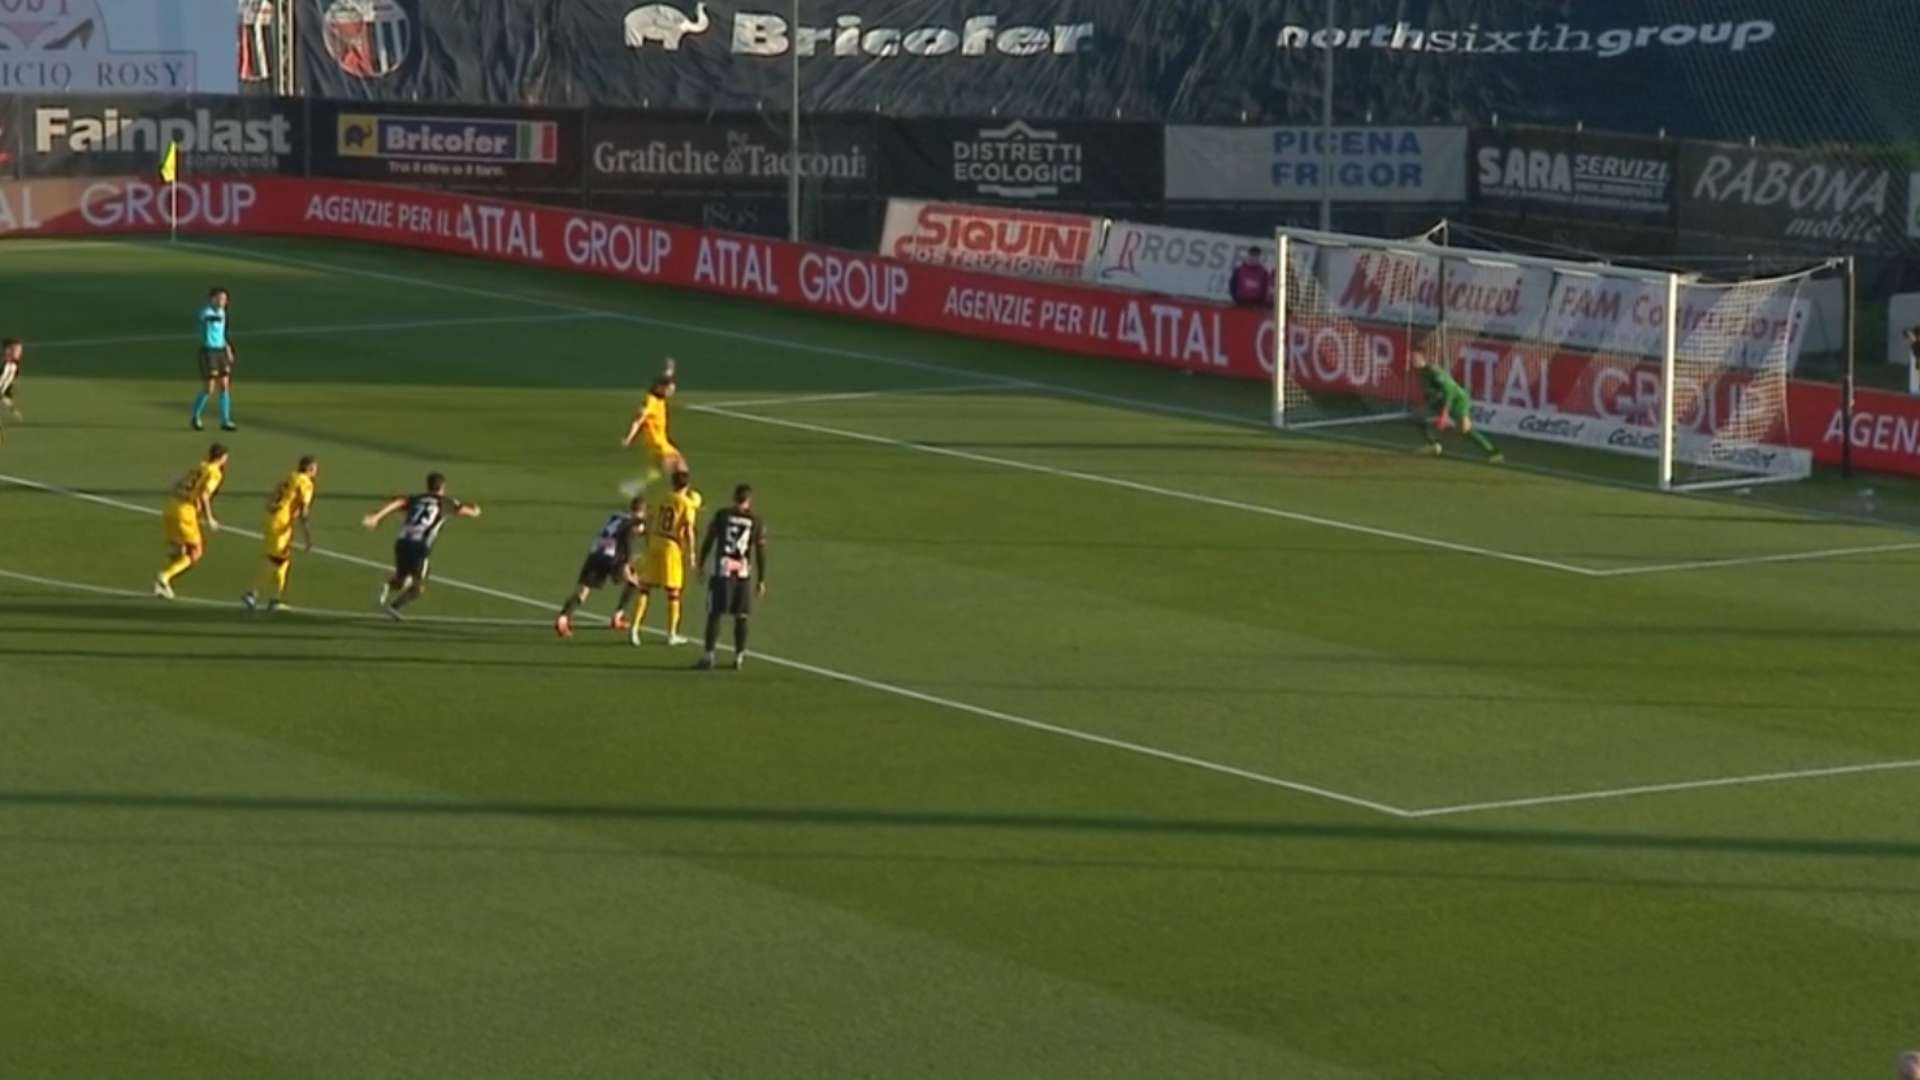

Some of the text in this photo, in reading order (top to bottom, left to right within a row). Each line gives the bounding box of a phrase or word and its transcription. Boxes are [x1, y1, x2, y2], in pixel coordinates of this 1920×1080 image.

[732, 12, 1094, 57] Bricofer
[96, 61, 183, 87] ROSY
[36, 108, 292, 154] Fainplast
[385, 124, 508, 155] Bricofer
[1273, 130, 1421, 155] PICENA
[593, 140, 720, 174] Grafiche
[748, 145, 860, 178] Tacconi
[954, 141, 1081, 162] DISTRETTI
[954, 163, 1081, 183] ECOLOGICI
[1271, 161, 1422, 188] FRIGOR
[1477, 147, 1572, 193] SARA
[1574, 154, 1667, 180] SERVIZI
[1693, 154, 1888, 215] RABONA
[80, 181, 256, 226] GROUP
[305, 195, 394, 229] AGENZIE
[397, 202, 433, 232] PER
[436, 208, 452, 236] IL
[563, 216, 672, 275] GROUP
[694, 236, 779, 294] ATTAL
[799, 252, 909, 313] GROUP
[944, 286, 1032, 329] AGENZIE
[1038, 305, 1083, 334] PER
[1455, 344, 1557, 410] TTAL
[1824, 409, 1920, 455] AGEN
[725, 524, 751, 557] 54
